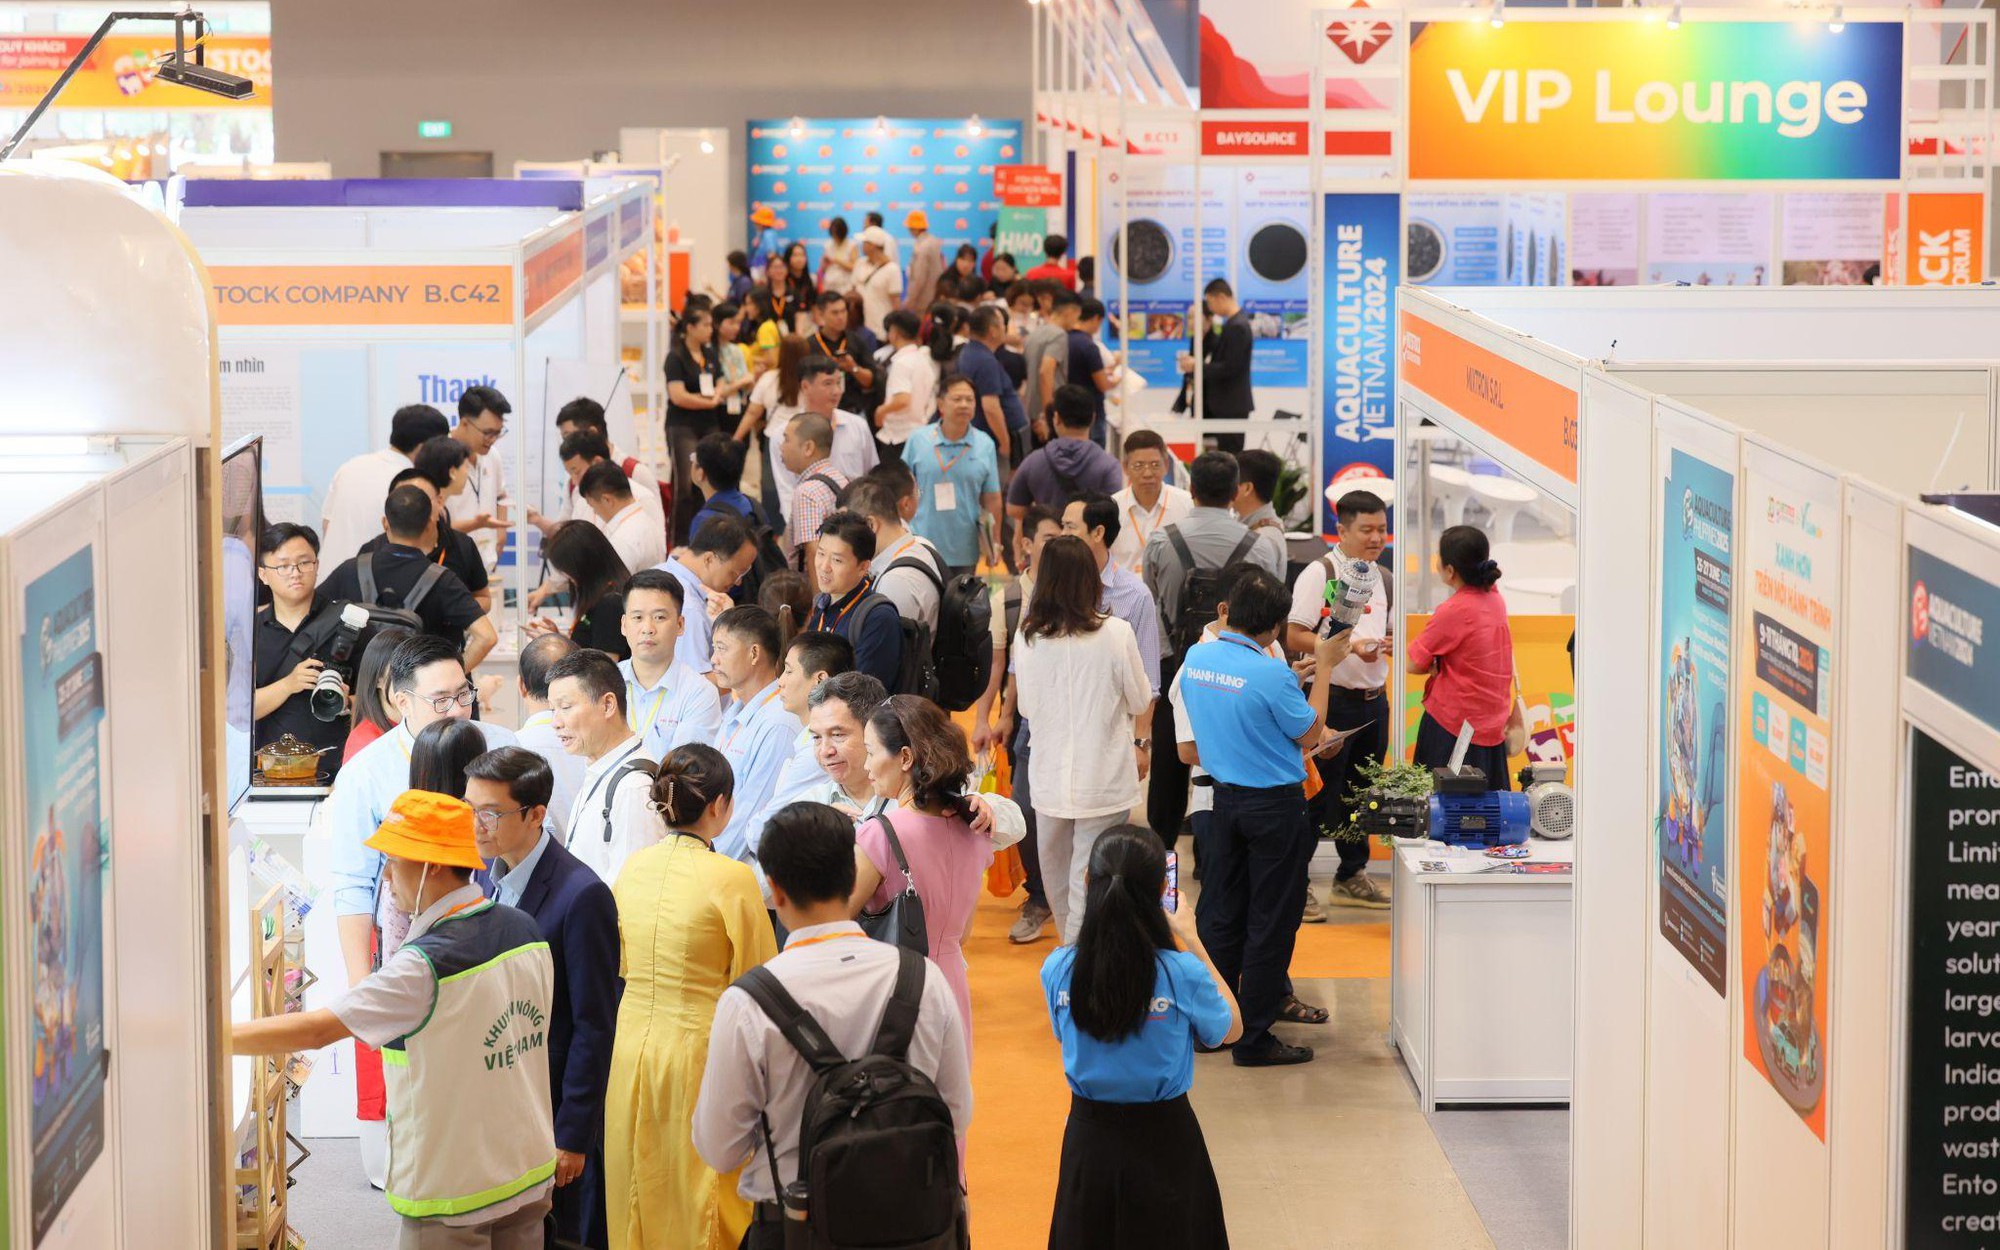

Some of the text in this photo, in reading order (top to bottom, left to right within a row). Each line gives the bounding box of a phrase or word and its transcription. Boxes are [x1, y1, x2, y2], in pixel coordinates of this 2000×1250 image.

[1445, 68, 1868, 139] VIP Lounge
[1216, 131, 1298, 146] BAYSOURCE
[1918, 230, 1951, 286] CK
[285, 284, 410, 304] COMPANY
[424, 284, 500, 303] B.C42
[1334, 224, 1363, 442] AQUACULTURE
[1187, 667, 1216, 682] THANH
[1948, 841, 2000, 863] Limi
[1942, 1173, 1998, 1195] Ento
